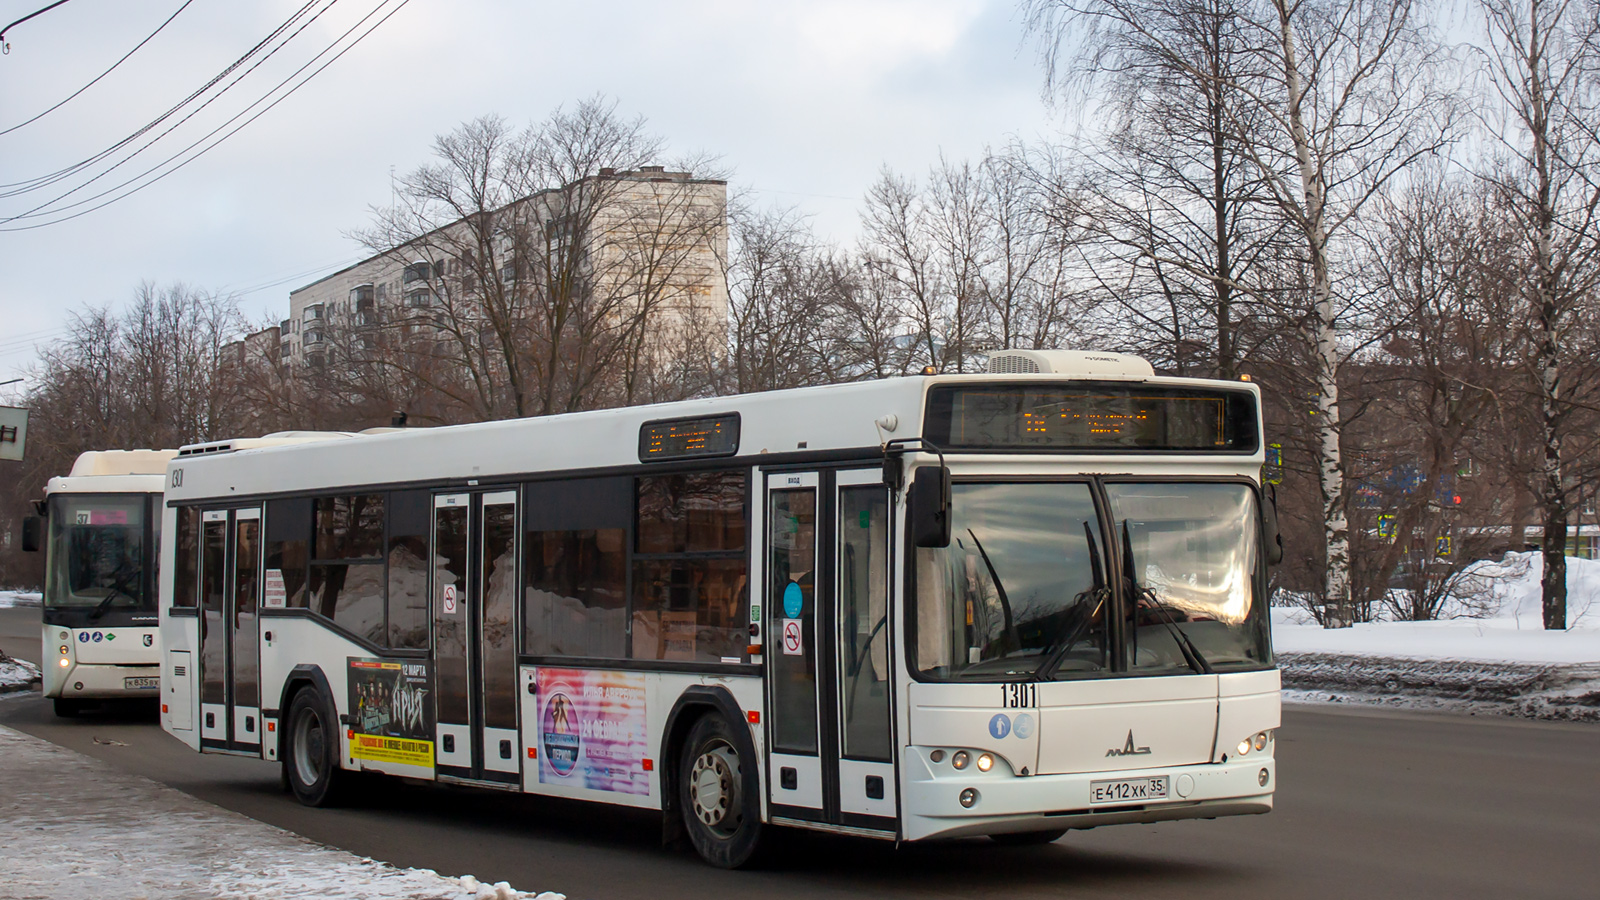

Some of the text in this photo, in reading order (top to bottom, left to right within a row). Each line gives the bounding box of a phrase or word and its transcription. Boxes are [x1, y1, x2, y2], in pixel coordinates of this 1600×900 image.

[171, 468, 184, 488] 1301
[77, 513, 89, 524] 37
[402, 665, 408, 675] 12
[408, 664, 426, 677] МАРТА
[392, 675, 429, 731] АРИЯ
[1000, 683, 1036, 708] 1301
[1150, 779, 1163, 791] 35
